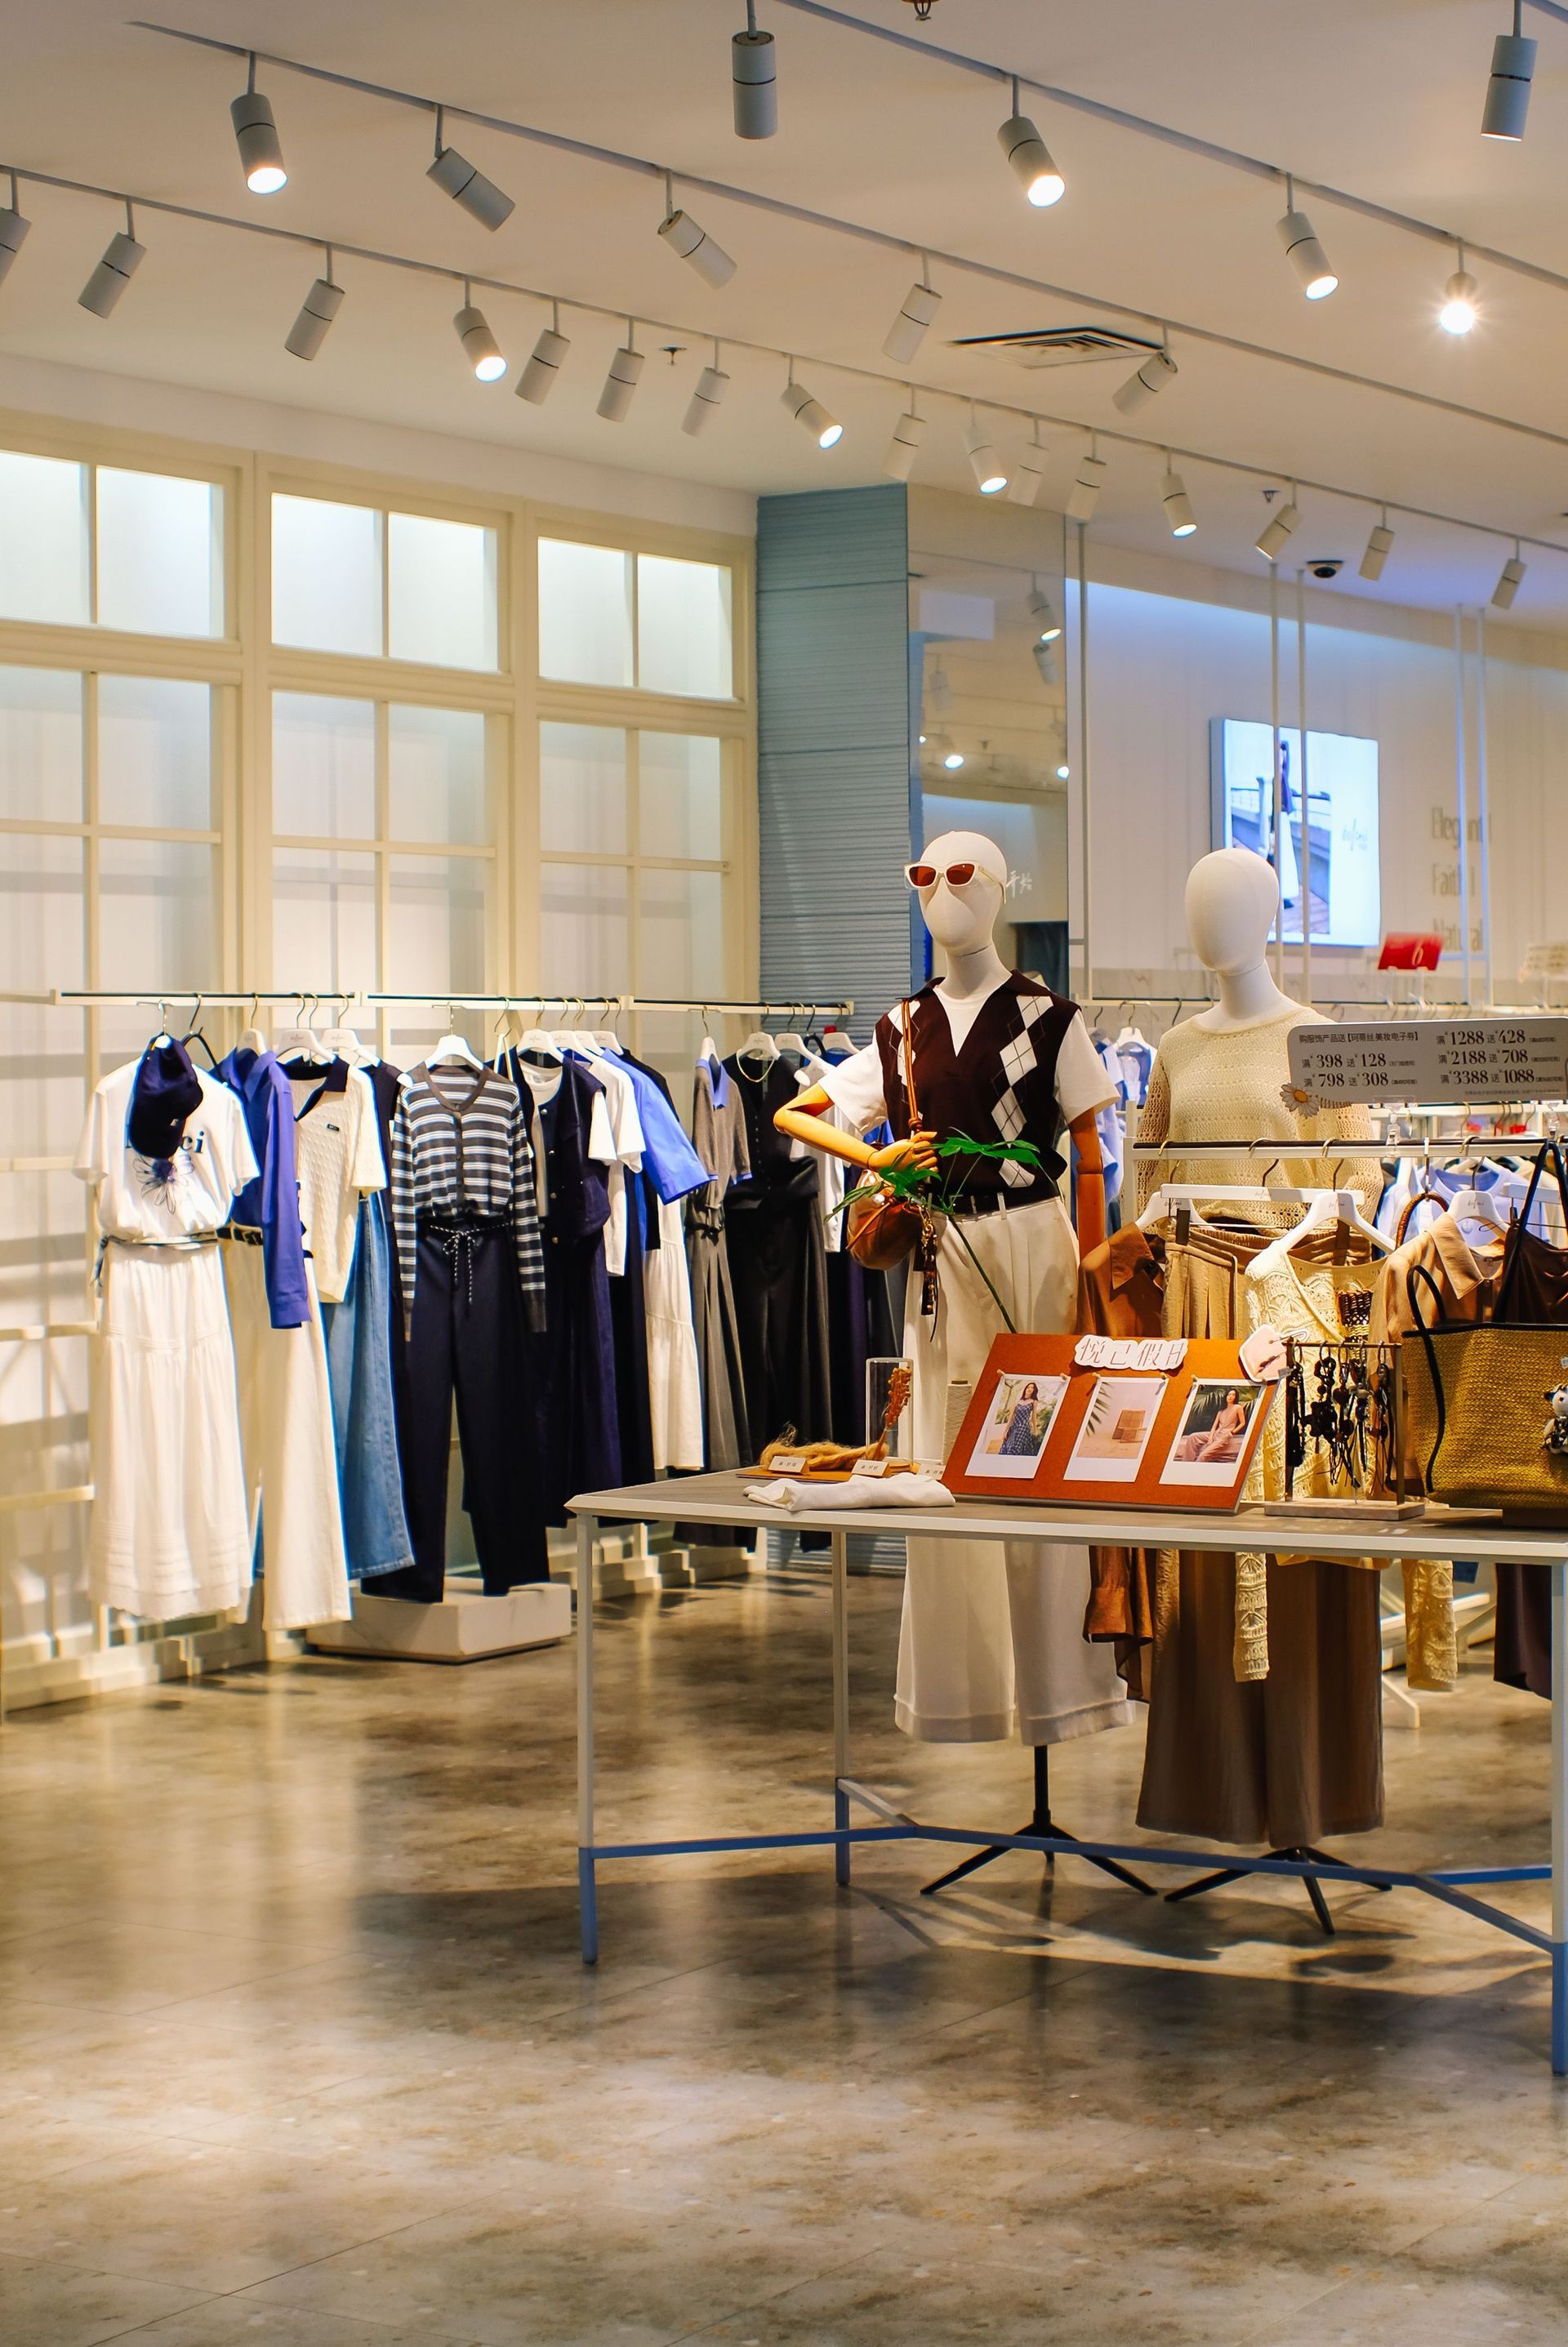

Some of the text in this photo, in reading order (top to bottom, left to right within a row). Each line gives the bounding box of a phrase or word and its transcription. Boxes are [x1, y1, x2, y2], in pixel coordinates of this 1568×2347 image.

[1432, 806, 1484, 850] Elegnt
[1436, 1035, 1446, 1044] 满
[1487, 1034, 1496, 1044] 送
[1302, 1058, 1311, 1068] 满
[1347, 1058, 1356, 1067] 送
[1438, 1054, 1448, 1064] 满
[1489, 1053, 1499, 1062] 送
[1304, 1077, 1313, 1088] 满
[1348, 1077, 1357, 1087] 送
[1440, 1074, 1450, 1084] 满
[1491, 1073, 1500, 1083] 送
[1081, 1338, 1184, 1367] 悦己假日
